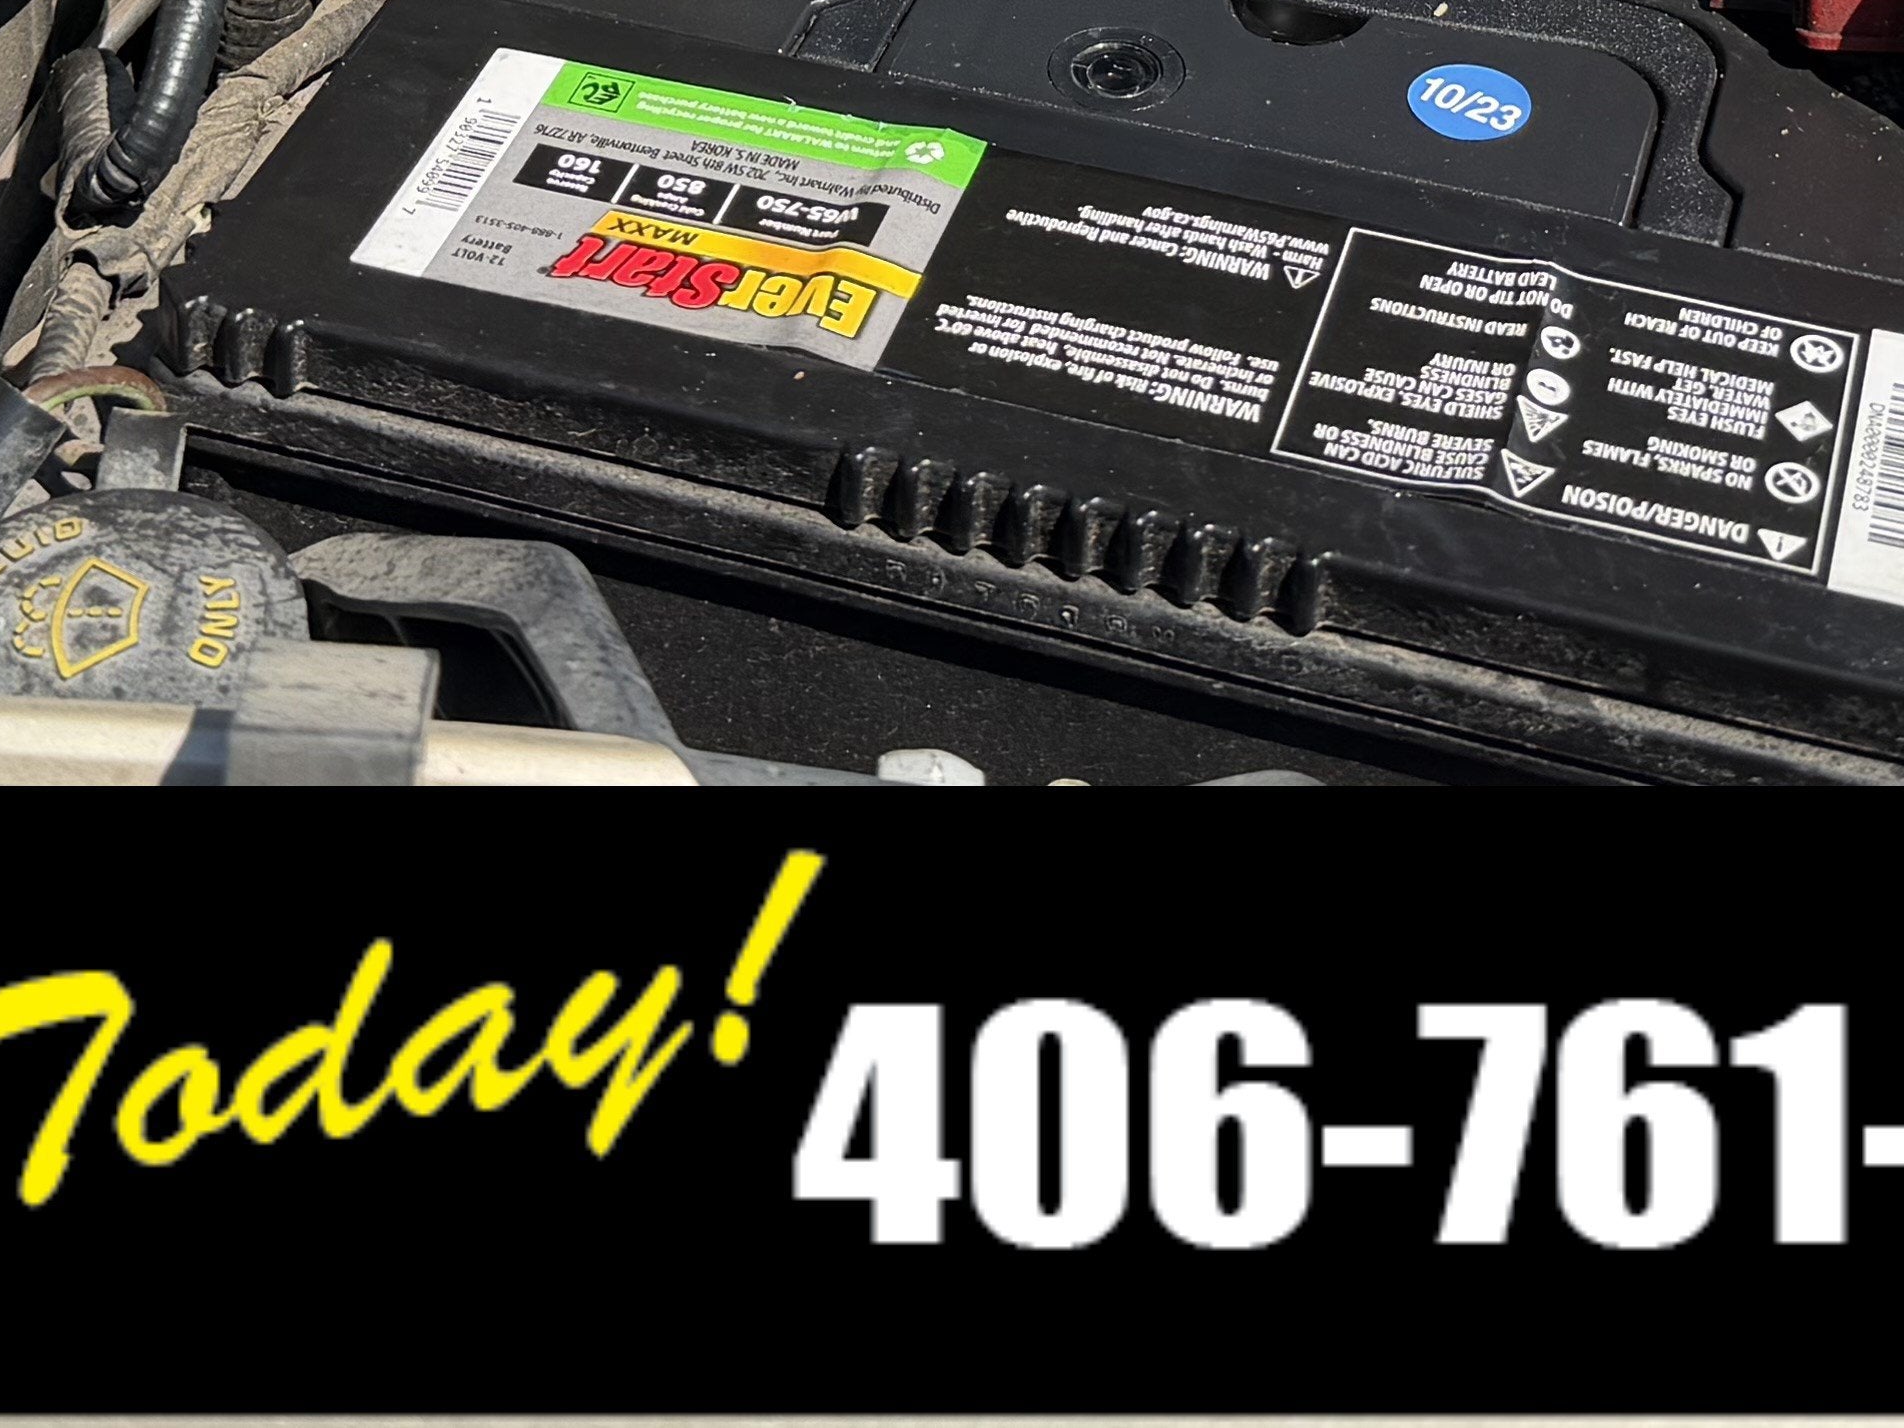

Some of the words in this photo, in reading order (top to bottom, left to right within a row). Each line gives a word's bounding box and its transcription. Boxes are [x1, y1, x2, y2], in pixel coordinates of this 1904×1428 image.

[1420, 77, 1522, 131] 10/23
[533, 124, 569, 140] 72716
[567, 130, 588, 143] AR
[590, 133, 661, 159] Bentonville,
[691, 140, 733, 158] KOREA
[735, 148, 747, 160] S.
[558, 154, 601, 174] 160
[662, 150, 702, 167] Street
[702, 157, 724, 171] 8th
[745, 151, 762, 163] IN
[760, 154, 800, 171] MADE
[722, 162, 747, 176] SW
[746, 166, 770, 181] 702
[657, 174, 706, 194] 850
[799, 177, 854, 198] Walmart
[756, 188, 859, 224] W65-750
[870, 184, 941, 214] Distributed
[1006, 209, 1102, 241] Reproductive
[1078, 205, 1145, 233] handling.
[606, 217, 699, 245] MAXX
[1098, 229, 1130, 244] and
[1142, 206, 1329, 255] www.P65Warnings.ca.gov
[1144, 221, 1182, 238] after
[461, 234, 512, 254] Battery
[1128, 235, 1179, 256] Cancer
[1182, 230, 1227, 250] hands
[1228, 238, 1269, 259] Wash
[451, 247, 505, 266] 12-VOLT
[1179, 246, 1270, 280] WARNING:
[1282, 250, 1323, 270] Harm
[542, 221, 883, 344] EverStart
[1446, 261, 1516, 286] BATTERY
[1517, 271, 1557, 291] LEAD
[1419, 274, 1463, 296] OPEN
[1464, 284, 1488, 301] OR
[1488, 289, 1514, 305] TIP
[1515, 285, 1550, 311] NOT
[935, 304, 1002, 328] inverted
[966, 295, 1059, 324] instructions.
[1370, 298, 1483, 332] INSTRUCTIONS
[1550, 298, 1573, 319] DO
[1001, 318, 1026, 332] for
[1058, 312, 1127, 339] charging
[1484, 321, 1527, 336] READ
[1624, 312, 1677, 335] REACH
[1679, 308, 1758, 335] CHILDREN
[973, 326, 1021, 345] above
[1025, 323, 1140, 356] recommended
[1126, 329, 1190, 352] product
[1678, 324, 1701, 340] OF
[1702, 329, 1737, 347] OUT
[1760, 326, 1783, 341] OF
[968, 342, 988, 354] or
[1020, 335, 1058, 355] heat
[1188, 343, 1241, 366] Follow
[1737, 338, 1779, 357] KEEP
[988, 343, 1062, 371] explosion
[1140, 348, 1171, 365] Not
[1247, 356, 1279, 372] use.
[1429, 353, 1490, 374] INJURY
[1609, 348, 1652, 370] FAST.
[1093, 370, 1114, 383] of
[1161, 367, 1190, 382] not
[1173, 354, 1255, 383] incinerate.
[1421, 364, 1512, 391] BLINDNESS
[1491, 363, 1516, 377] OR
[1653, 359, 1697, 379] HELP
[1114, 373, 1149, 393] Risk
[1190, 374, 1214, 390] Do
[1254, 373, 1274, 385] or
[1308, 371, 1395, 402] EXPLOSIVE
[1363, 368, 1417, 390] CAUSE
[1607, 378, 1653, 400] WITH
[1672, 377, 1706, 395] GET
[1700, 368, 1774, 396] MEDICAL
[1219, 379, 1270, 402] burns.
[1418, 380, 1453, 399] CAN
[1455, 387, 1508, 405] GASES
[1148, 381, 1264, 422] WARNING:
[1398, 390, 1444, 412] EYES.
[1443, 400, 1504, 420] SHIELD
[1654, 388, 1768, 424] IMMEDIATELY
[1667, 406, 1708, 427] EYES
[1710, 413, 1765, 439] FLUSH
[1313, 423, 1339, 440] OR
[1367, 419, 1431, 446] BURNS.
[1433, 433, 1495, 450] SEVERE
[1324, 442, 1360, 461] CAN
[1340, 430, 1436, 462] BLINDNESS
[1582, 440, 1651, 467] FLAMES
[1647, 436, 1729, 467] SMOKING
[1361, 451, 1403, 471] ACID
[1436, 449, 1490, 467] CAUSE
[1730, 454, 1756, 473] OR
[1404, 462, 1485, 481] SULFURIC
[1653, 454, 1724, 483] SPARKS,
[1725, 472, 1753, 490] NO
[1561, 485, 1749, 543] DANGER/POISON
[188, 575, 240, 668] ONLY
